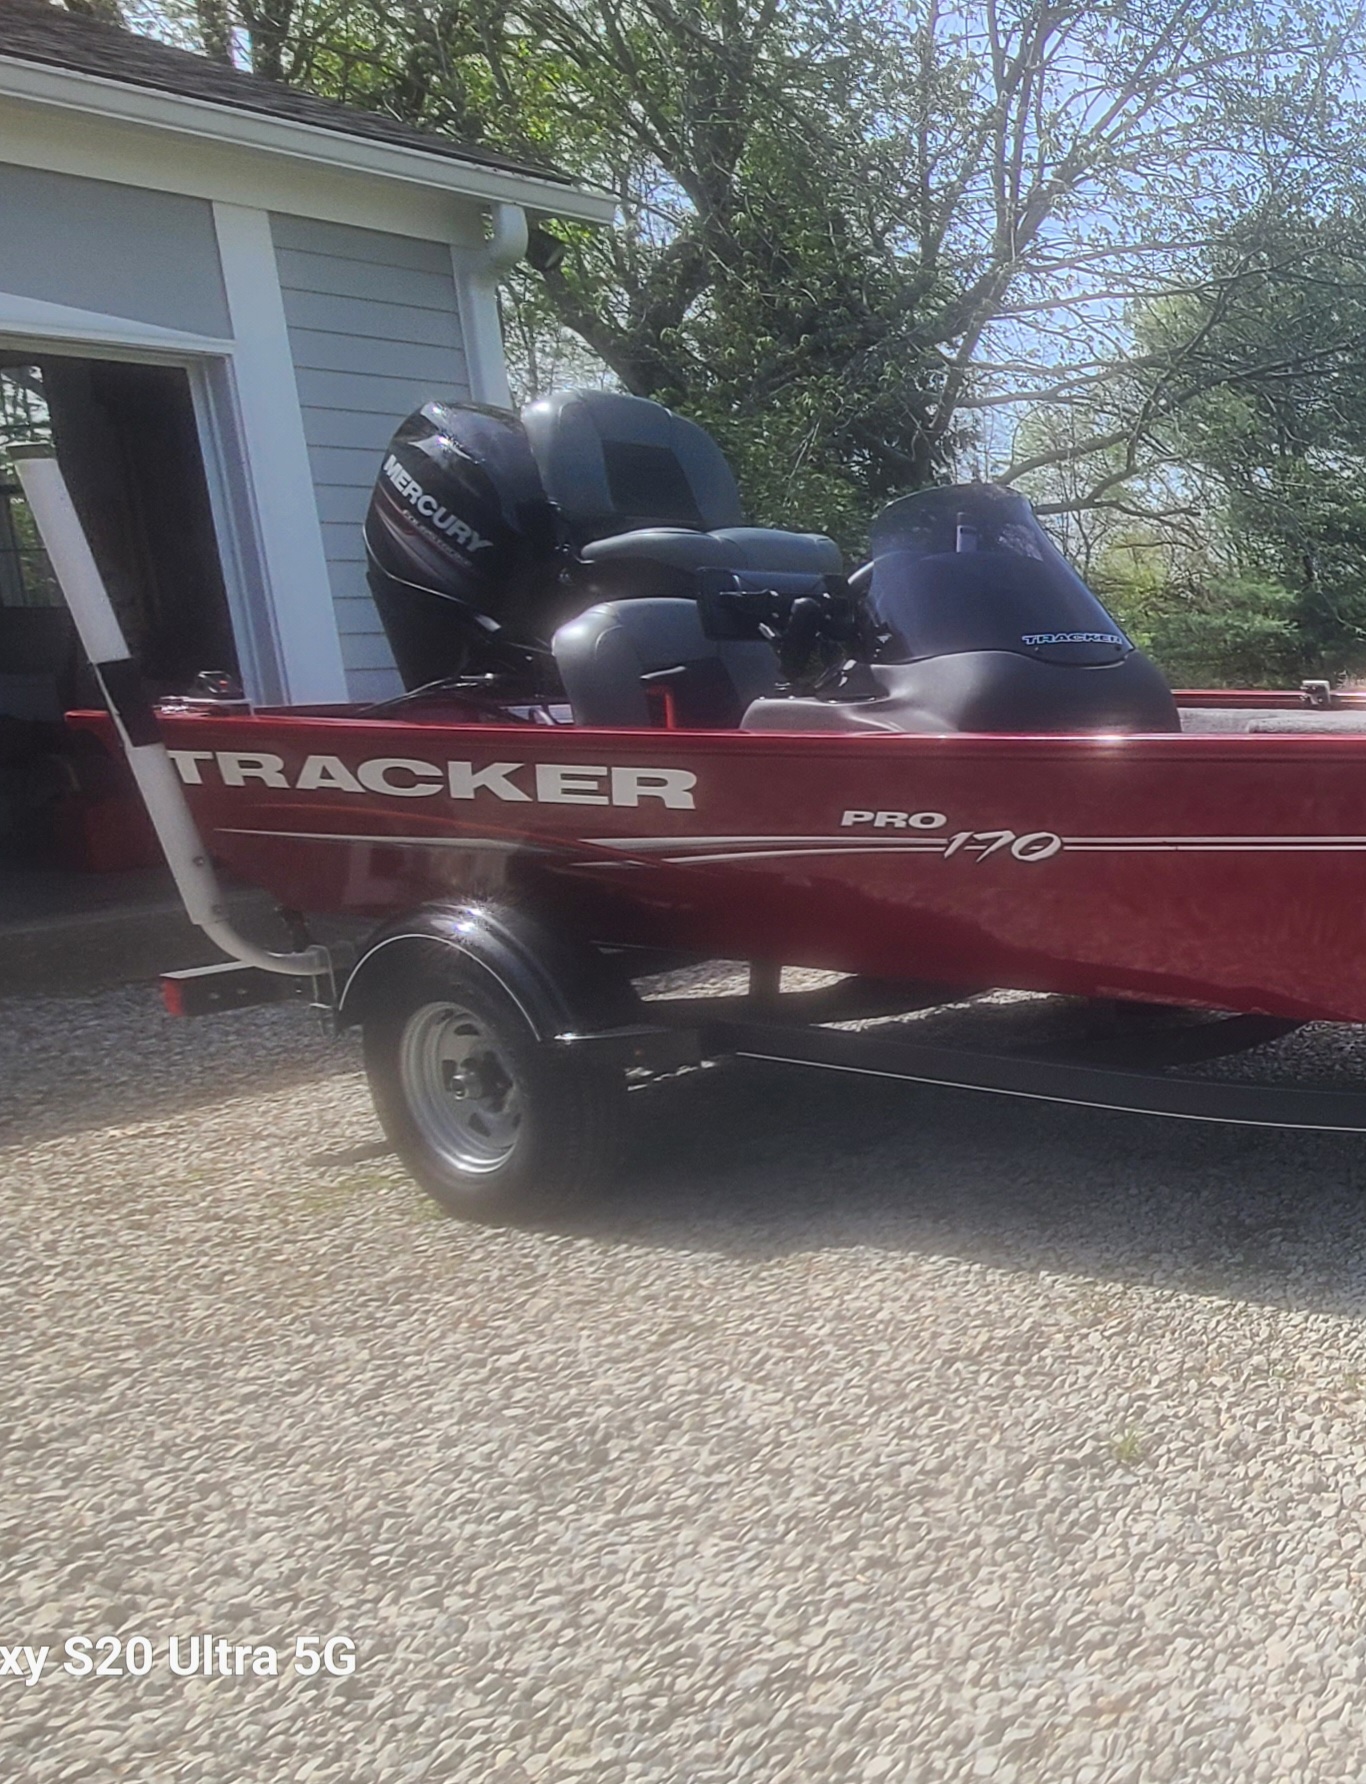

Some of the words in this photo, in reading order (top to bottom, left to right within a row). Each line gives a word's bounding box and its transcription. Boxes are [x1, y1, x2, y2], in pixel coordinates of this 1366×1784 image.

[383, 454, 494, 552] MERCURY
[1022, 633, 1122, 645] TRACKER
[169, 750, 698, 809] TRACKER
[841, 811, 947, 828] PRO
[944, 830, 1061, 862] 170
